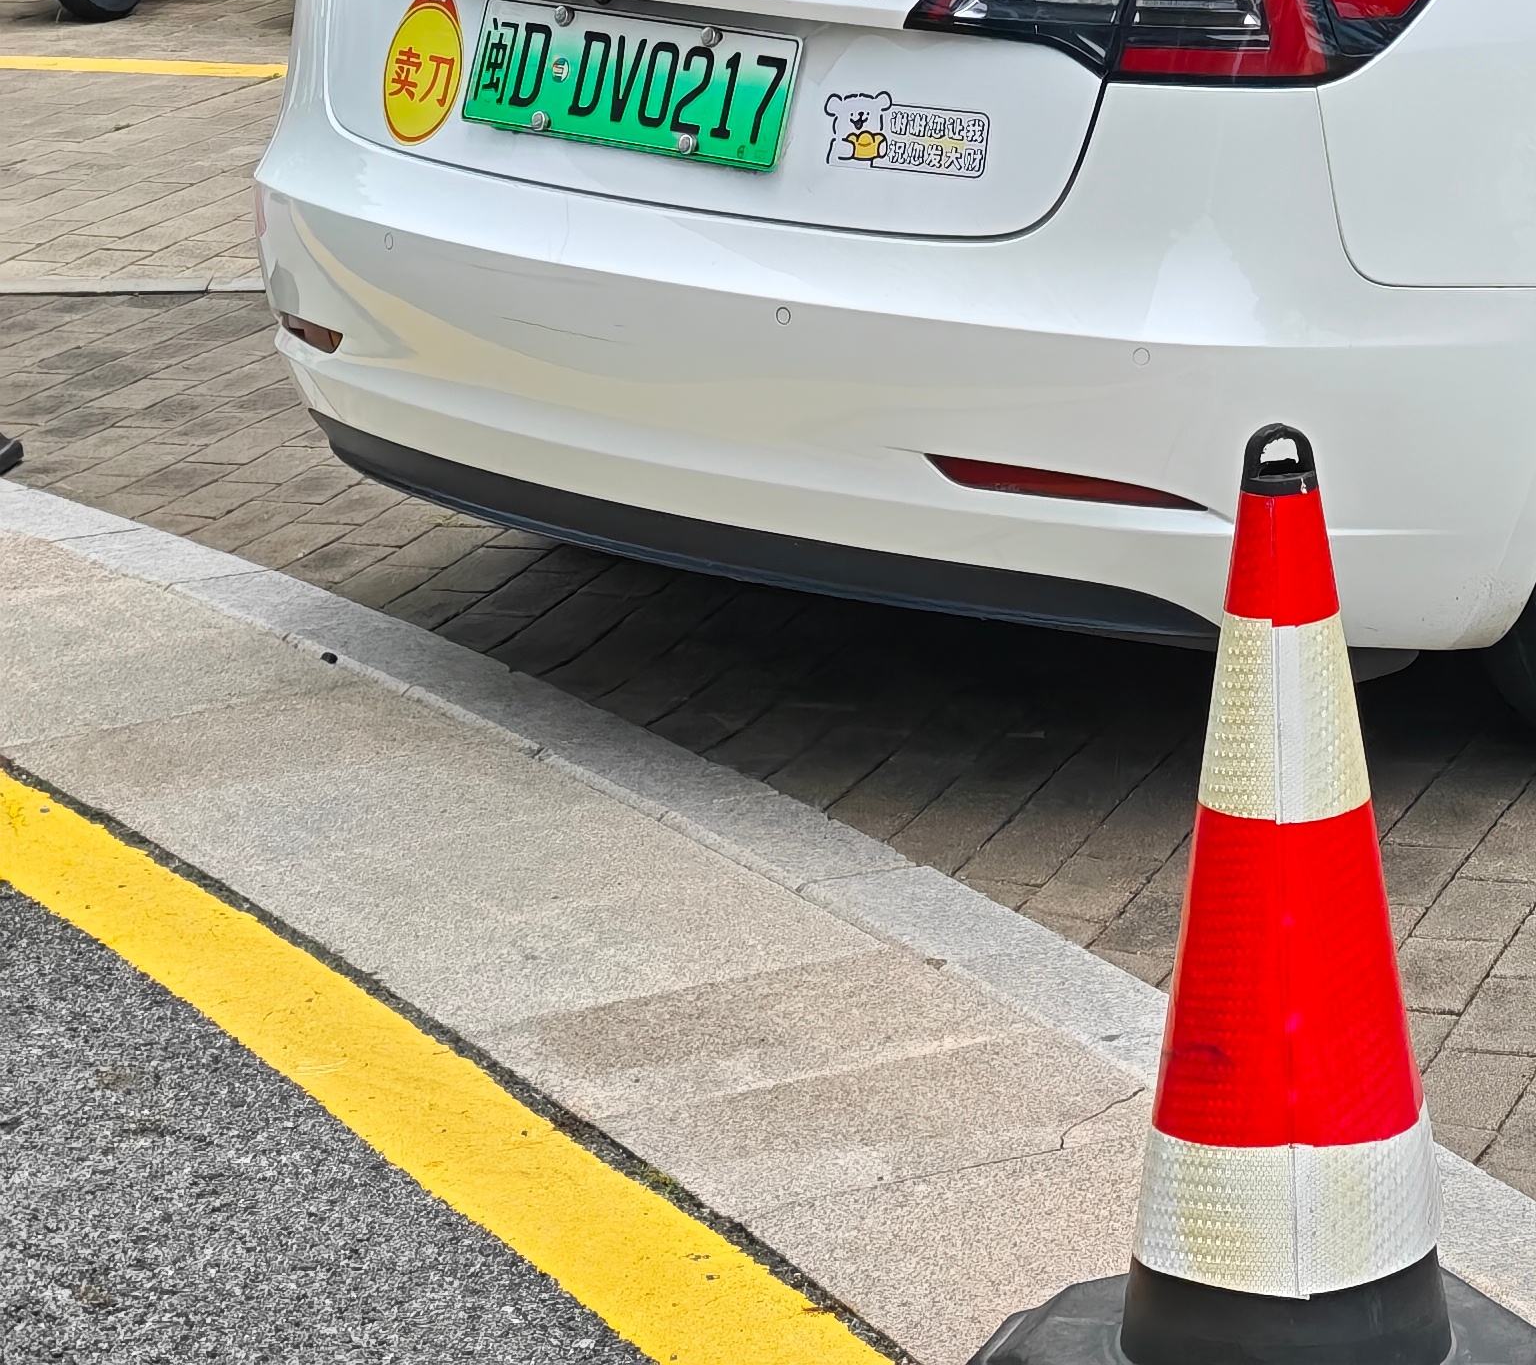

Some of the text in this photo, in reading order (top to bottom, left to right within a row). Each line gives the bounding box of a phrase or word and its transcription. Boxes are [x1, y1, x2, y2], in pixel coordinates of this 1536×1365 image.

[388, 46, 456, 108] 卖刀
[472, 17, 789, 145] 闽D DV0217
[889, 110, 986, 144] 谢谢您让我
[886, 139, 984, 173] 祝您发大财
